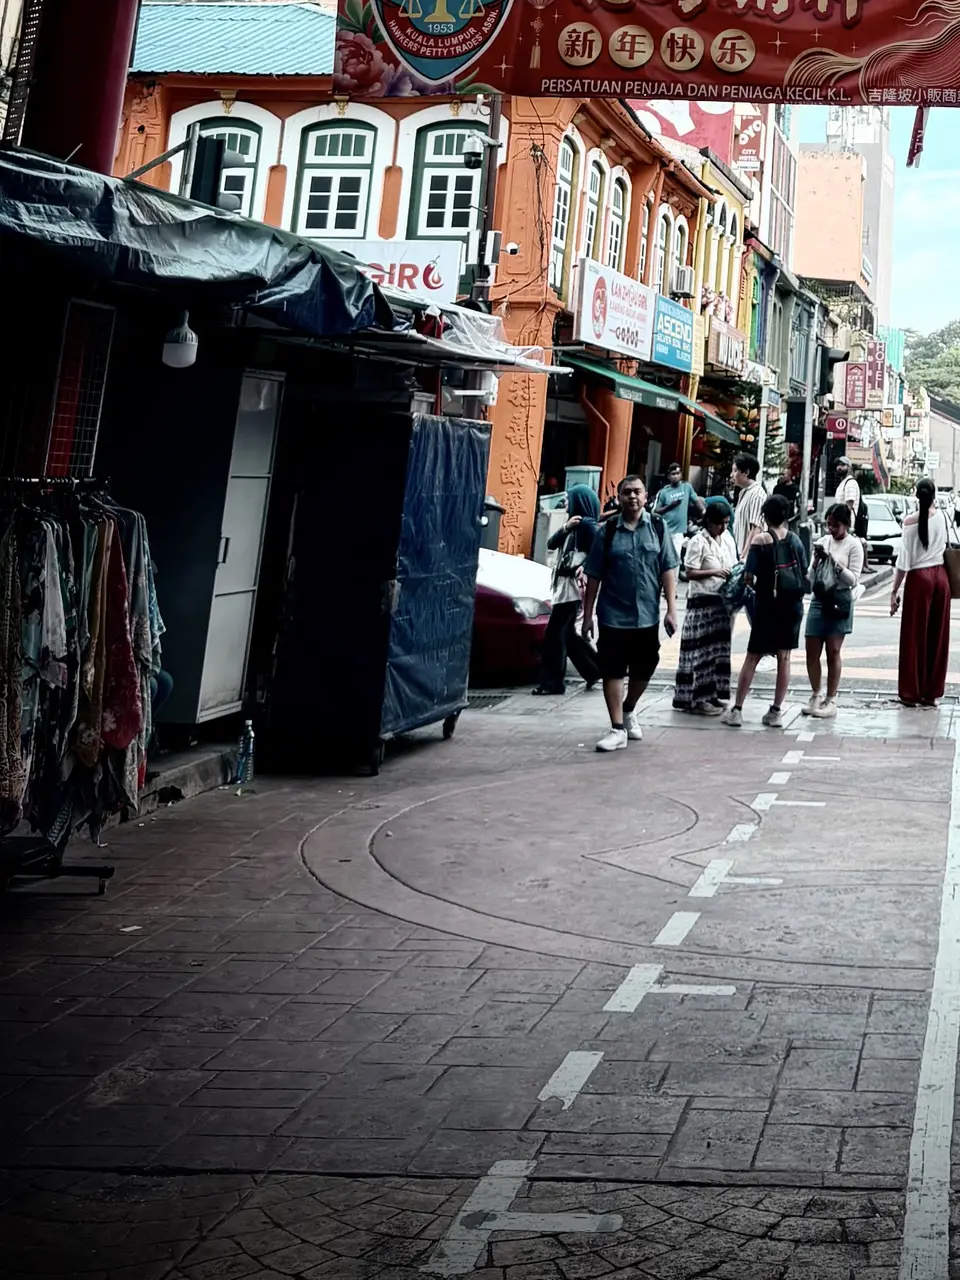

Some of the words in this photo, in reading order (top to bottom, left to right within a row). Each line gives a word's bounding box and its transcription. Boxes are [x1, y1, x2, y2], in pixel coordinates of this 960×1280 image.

[405, 27, 436, 47] KUALA
[438, 26, 479, 47] LUMPUR
[419, 44, 449, 56] PETTY
[481, 9, 500, 35] ASSN.
[427, 23, 454, 33] 1953
[562, 28, 751, 66] 新年快乐
[540, 79, 621, 96] PERSATUAN
[623, 81, 684, 97] PENJAJA
[686, 82, 717, 97] DAN
[719, 83, 783, 99] PENIAGA
[785, 85, 827, 100] KECIL
[829, 86, 851, 100] K.L.
[657, 312, 692, 344] ASCEND
